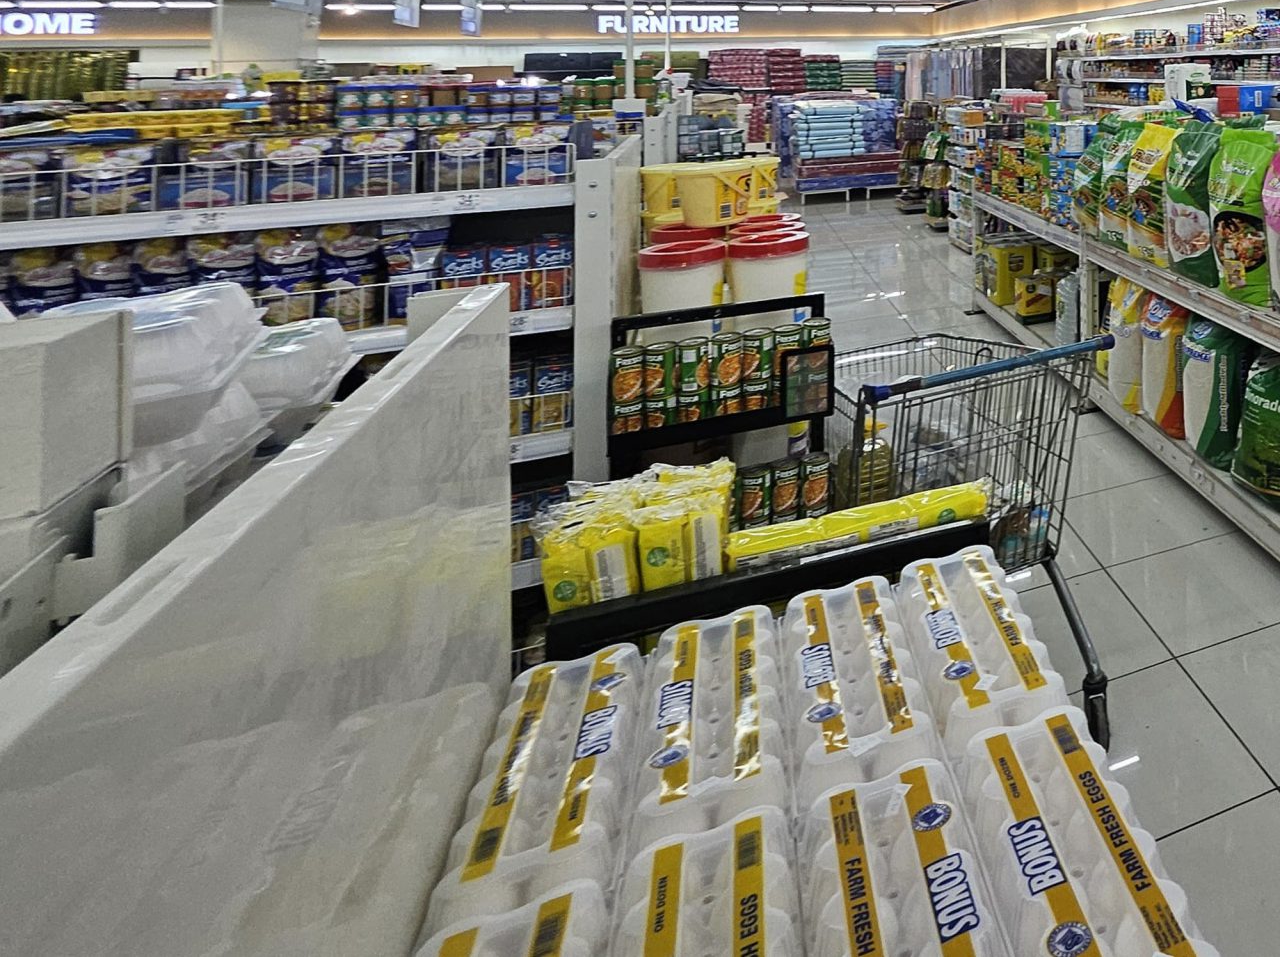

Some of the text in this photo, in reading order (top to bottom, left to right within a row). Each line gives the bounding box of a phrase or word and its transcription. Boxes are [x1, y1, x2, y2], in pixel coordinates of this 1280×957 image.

[0, 13, 95, 34] OME
[598, 15, 739, 33] FURNITURE
[1078, 770, 1152, 892] FARM FRESH EGGS
[845, 857, 865, 901] FARM
[1007, 815, 1067, 896] BONUS
[655, 876, 668, 908] DOZEN
[924, 853, 980, 944] BONUS
[739, 893, 758, 940] EGGS
[852, 902, 876, 957] FRESH
